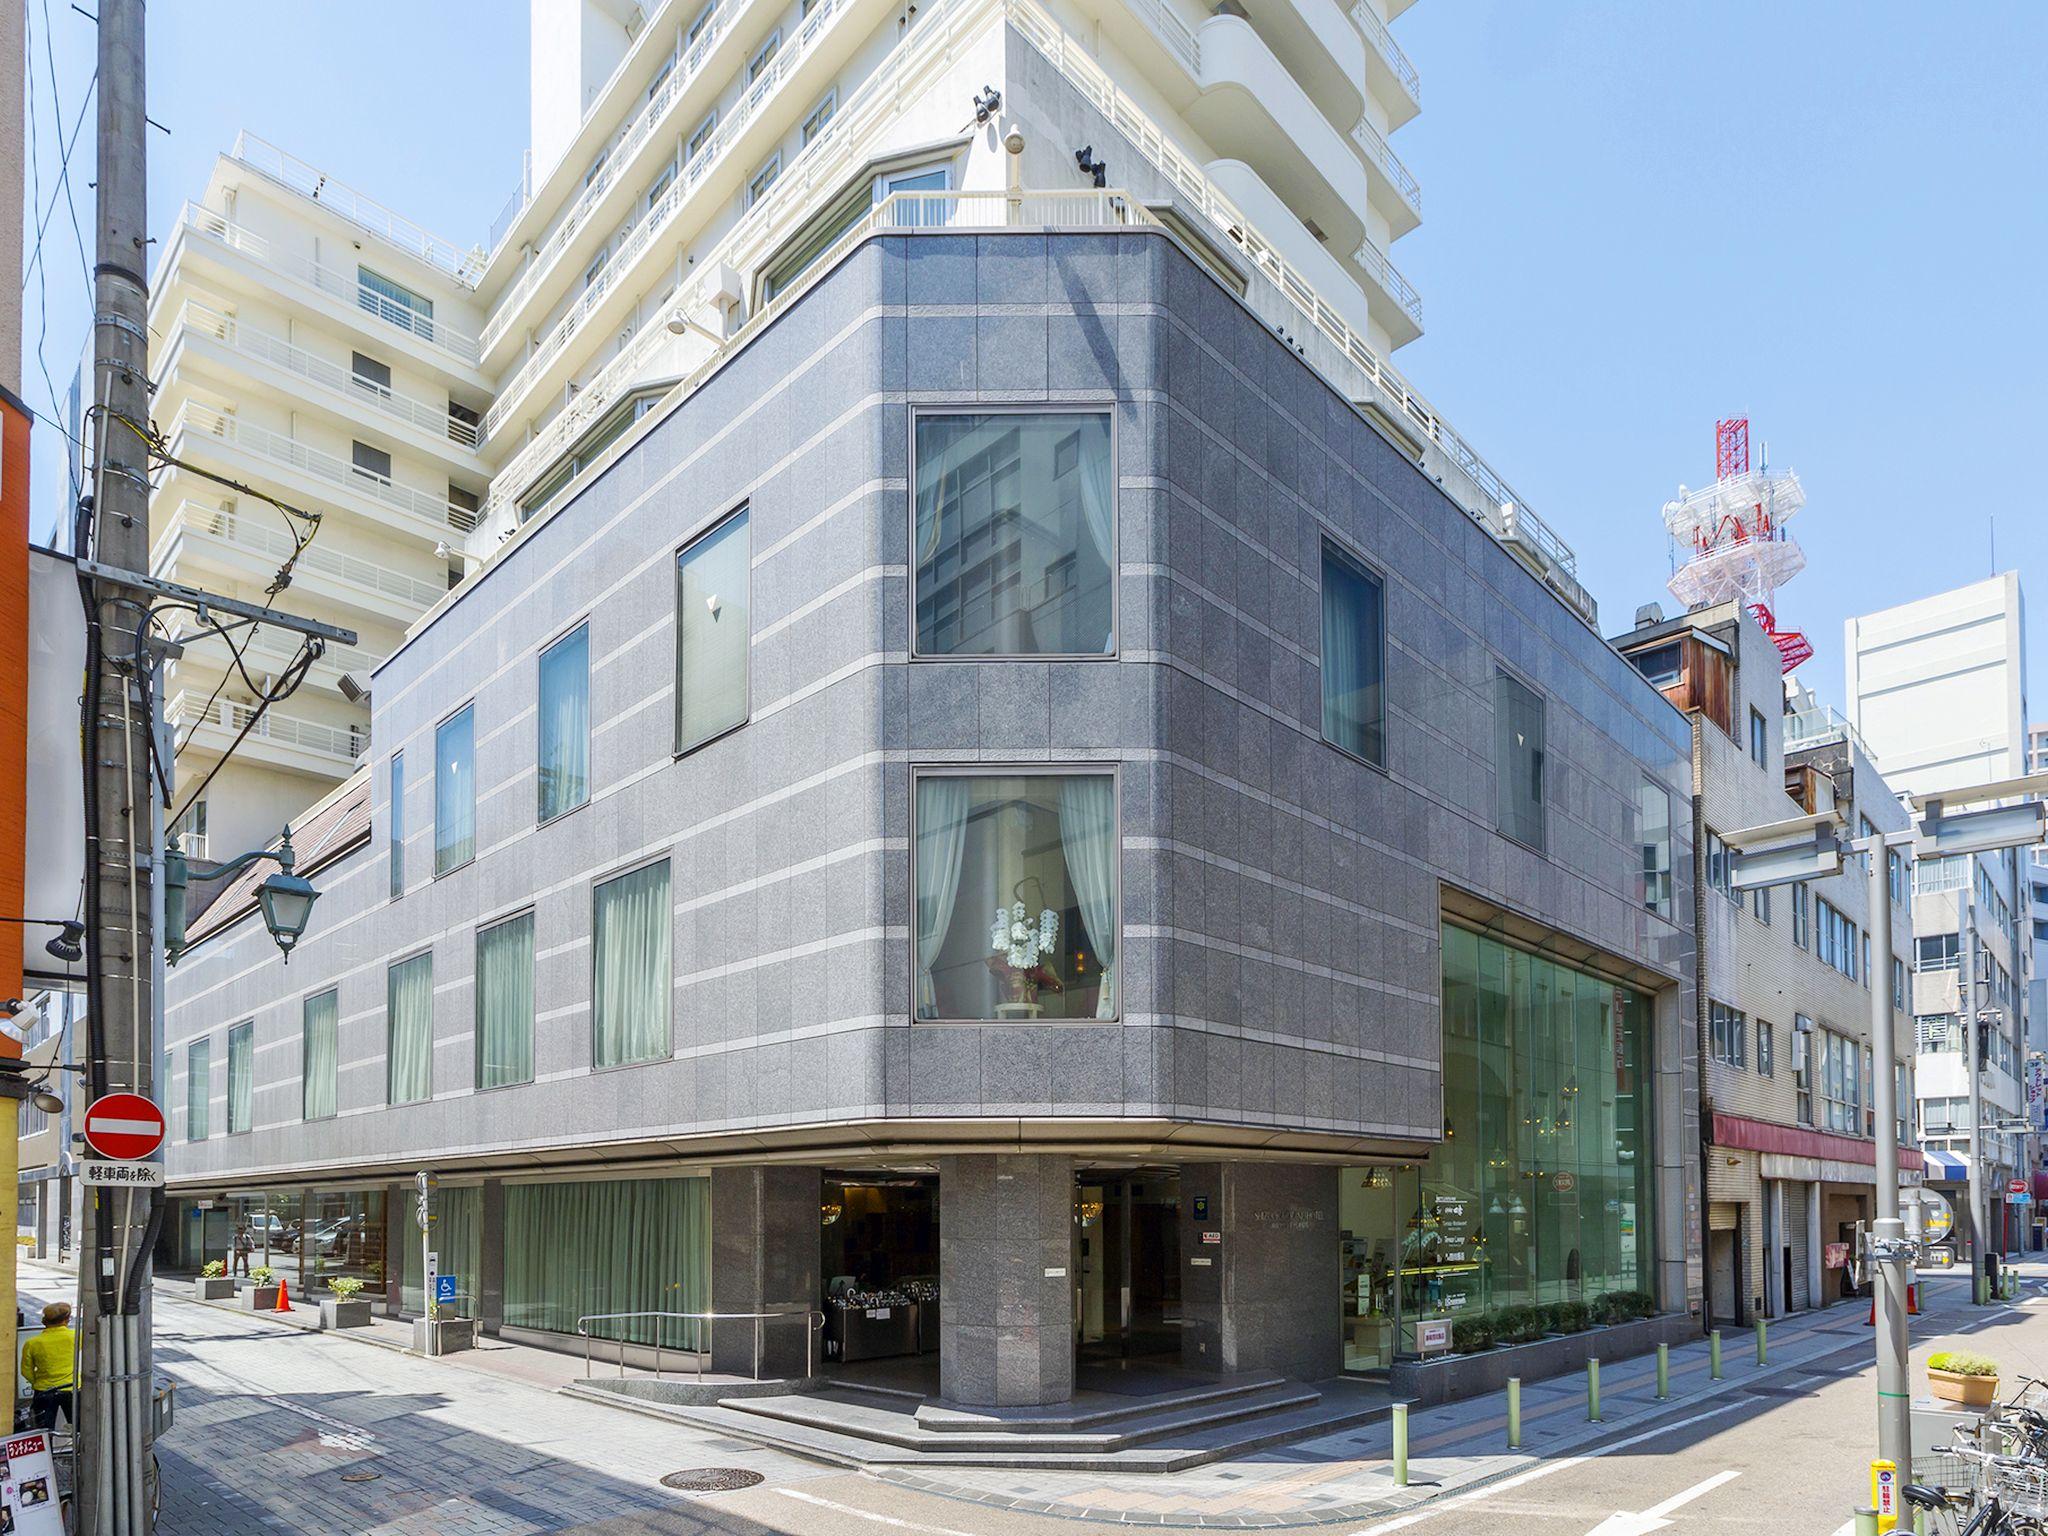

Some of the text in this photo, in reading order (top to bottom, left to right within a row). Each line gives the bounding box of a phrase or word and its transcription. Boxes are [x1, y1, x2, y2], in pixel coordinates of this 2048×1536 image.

[88, 1165, 156, 1182] 軽車両を除く
[8, 1440, 43, 1457] ランチメニュー
